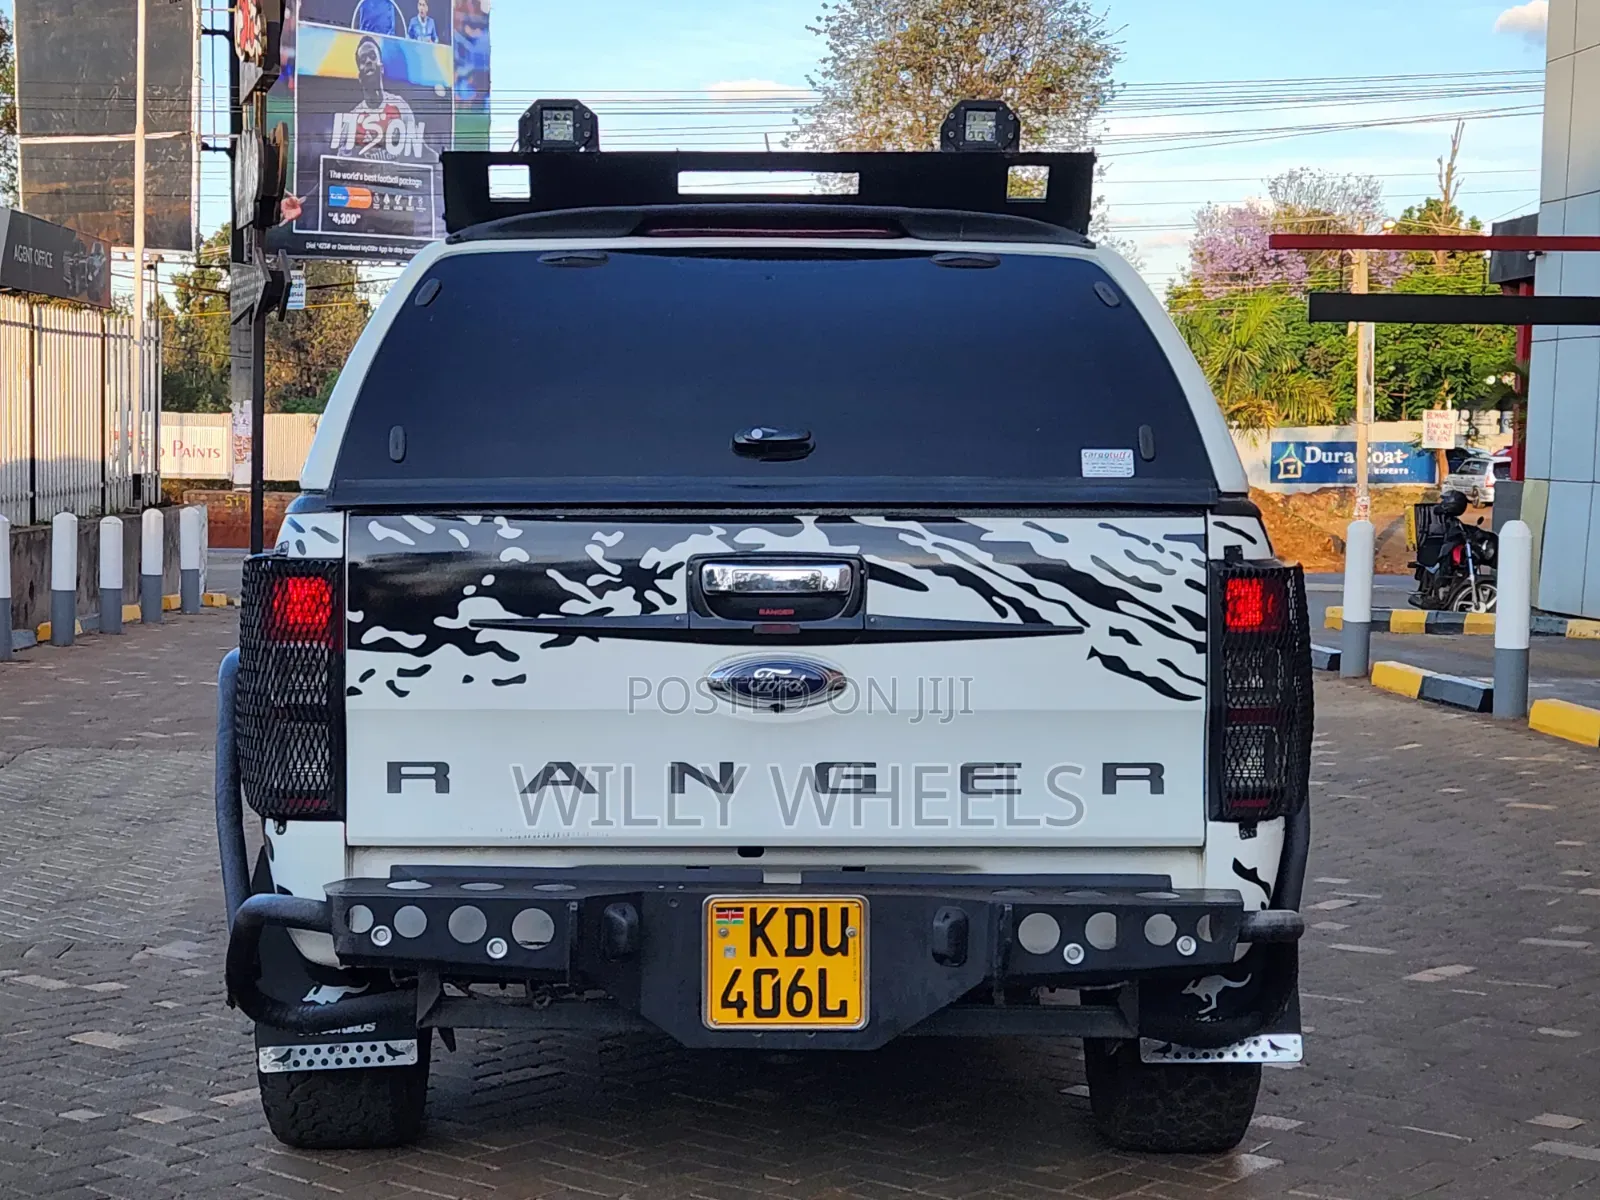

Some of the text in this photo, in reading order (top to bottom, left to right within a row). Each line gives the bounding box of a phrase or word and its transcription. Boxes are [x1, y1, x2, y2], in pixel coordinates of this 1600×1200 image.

[386, 117, 426, 158] ON
[329, 169, 422, 189] The world's best football package
[14, 243, 54, 269] AGENT OFFICE
[758, 608, 795, 616] RANGER
[747, 667, 806, 693] Ford
[387, 761, 1165, 795] RANGER
[749, 907, 849, 957] KDU
[720, 967, 848, 1018] 406L
